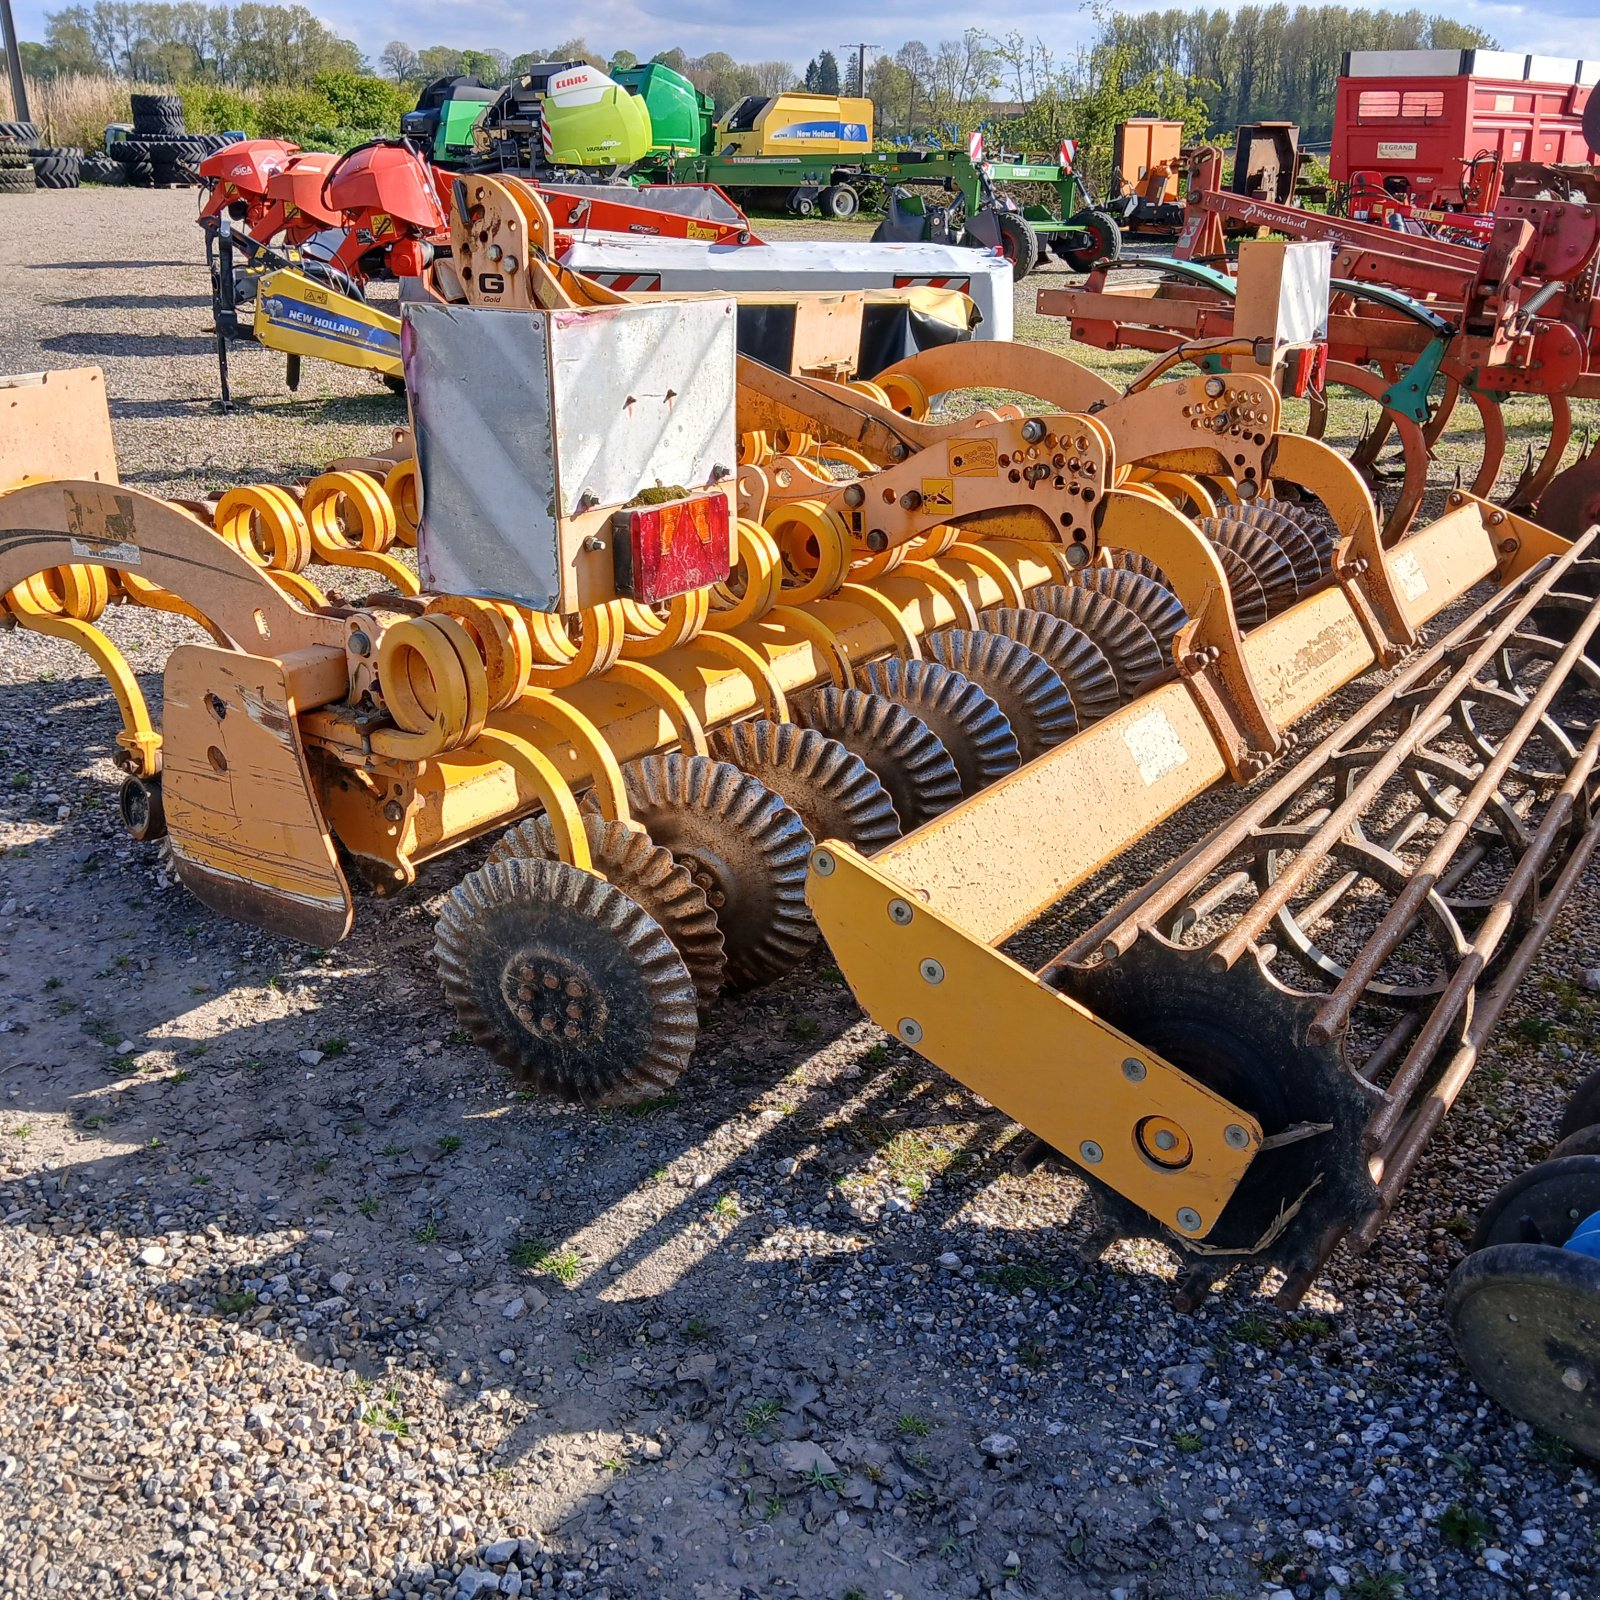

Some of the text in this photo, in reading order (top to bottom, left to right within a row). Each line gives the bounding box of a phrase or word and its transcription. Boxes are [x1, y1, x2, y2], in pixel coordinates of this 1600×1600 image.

[555, 74, 588, 89] CLAAS
[796, 130, 811, 138] New
[812, 129, 836, 138] Holland
[1256, 208, 1308, 229] Kverneland
[478, 273, 505, 294] G
[483, 295, 501, 303] Gold
[288, 309, 360, 337] NEW HOLLAND
